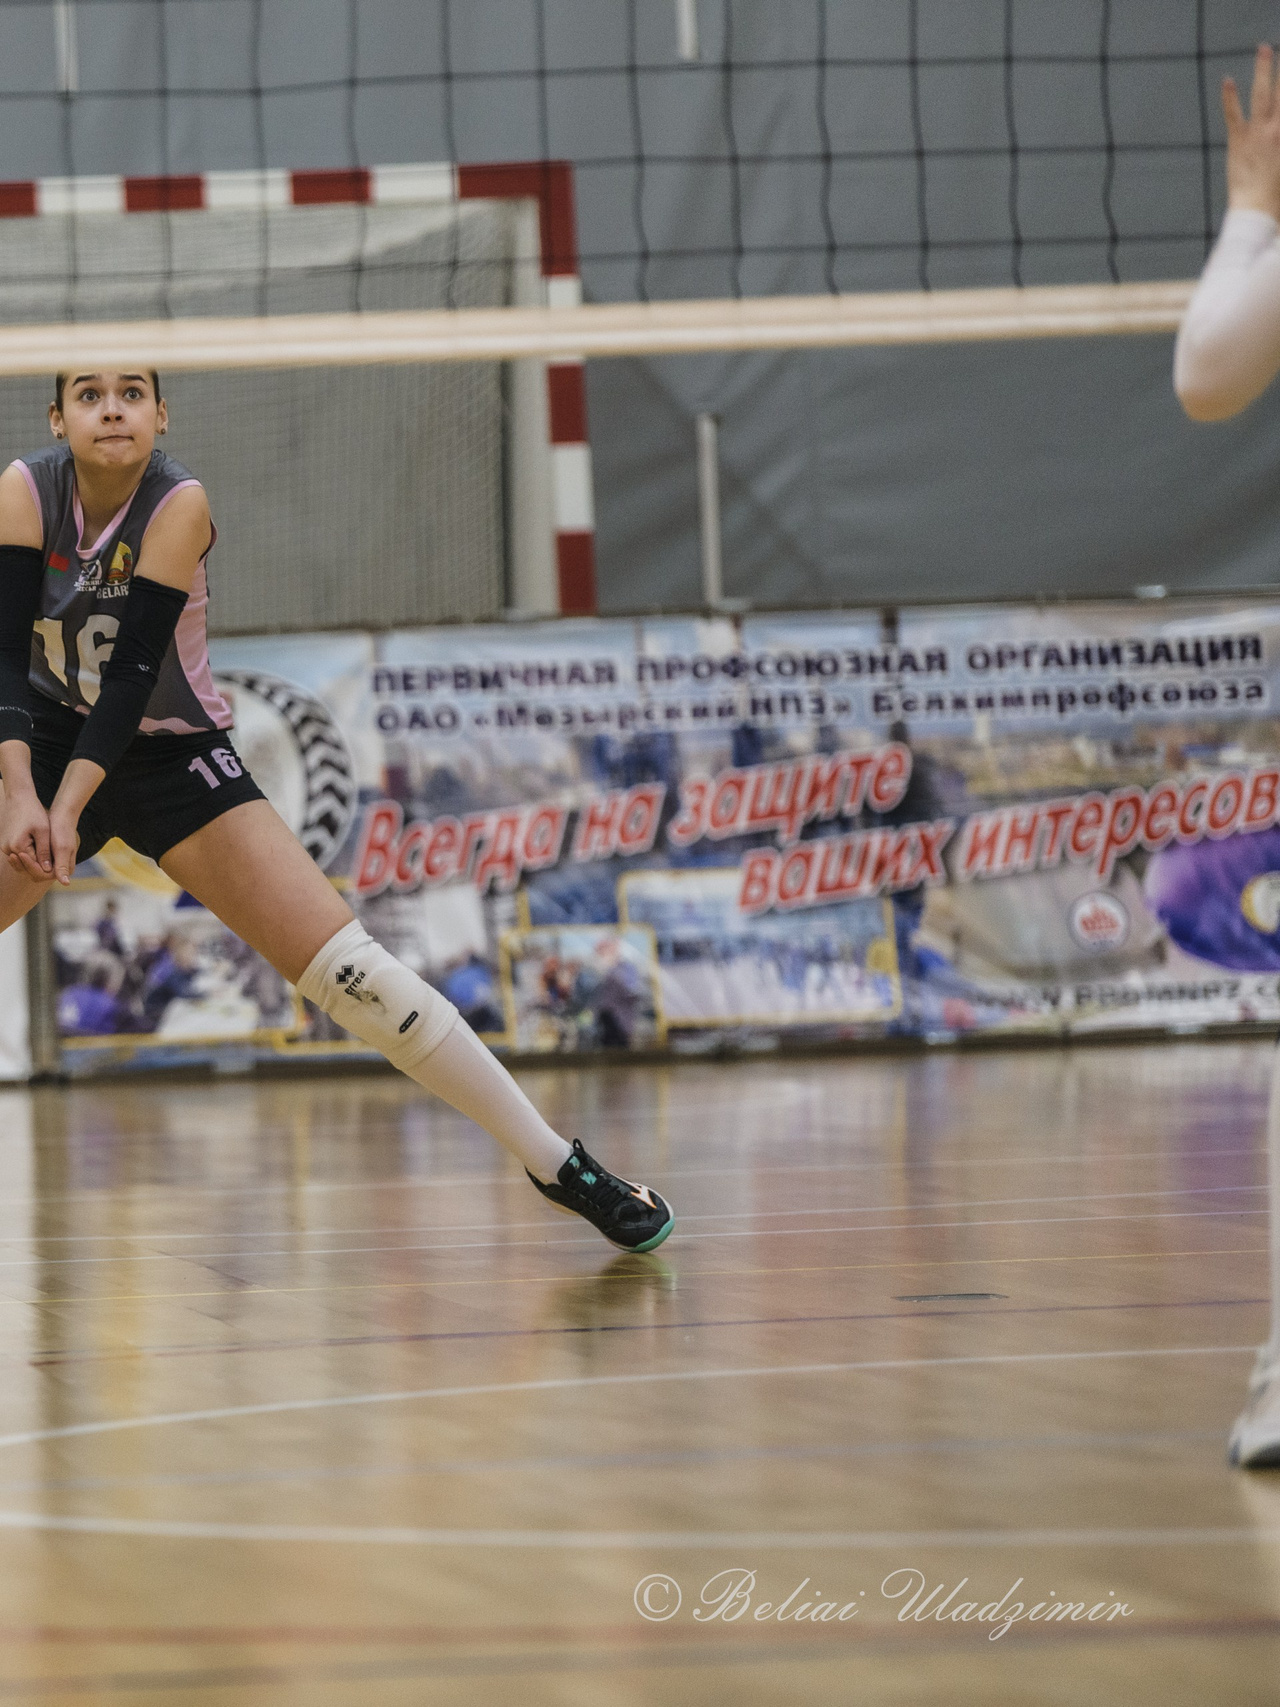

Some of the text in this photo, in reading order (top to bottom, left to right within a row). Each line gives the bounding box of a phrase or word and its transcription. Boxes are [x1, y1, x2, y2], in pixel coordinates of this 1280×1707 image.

[373, 634, 1263, 694] ПЕРВИЧНАЯ ПРОФСОЮЗНАЯ ОРГАНИЗАЦИЯ
[376, 703, 459, 732] ОАО
[188, 747, 242, 789] 16
[356, 744, 910, 892] Всегда на защите
[738, 770, 1280, 912] ваших интересов
[344, 971, 366, 996] errea
